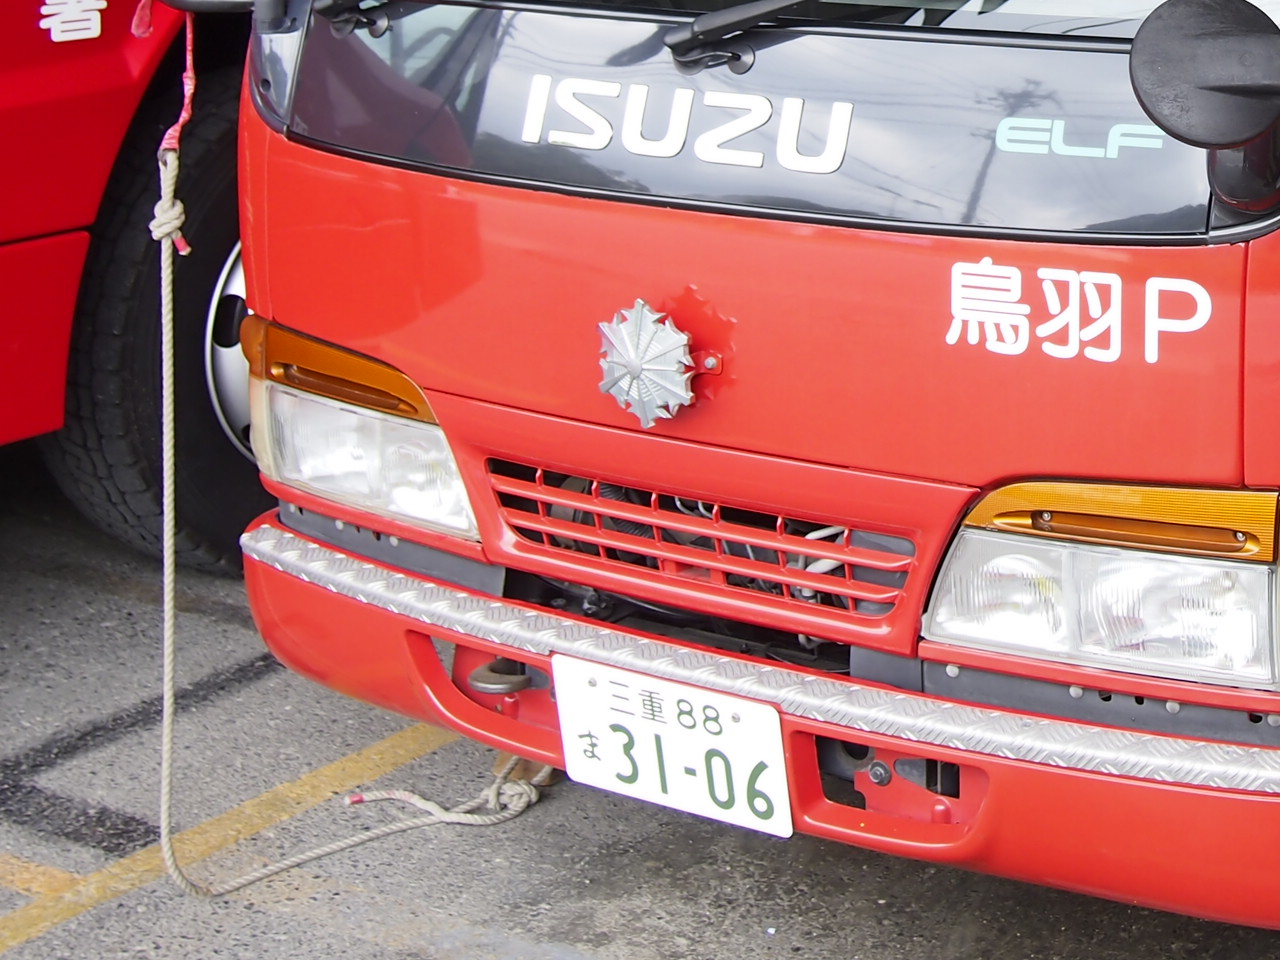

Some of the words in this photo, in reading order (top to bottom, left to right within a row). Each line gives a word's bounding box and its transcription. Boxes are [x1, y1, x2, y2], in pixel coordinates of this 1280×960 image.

[521, 73, 855, 175] ISUZU
[995, 116, 1167, 159] ELF
[577, 730, 602, 761] ま
[608, 723, 775, 821] 31-06
